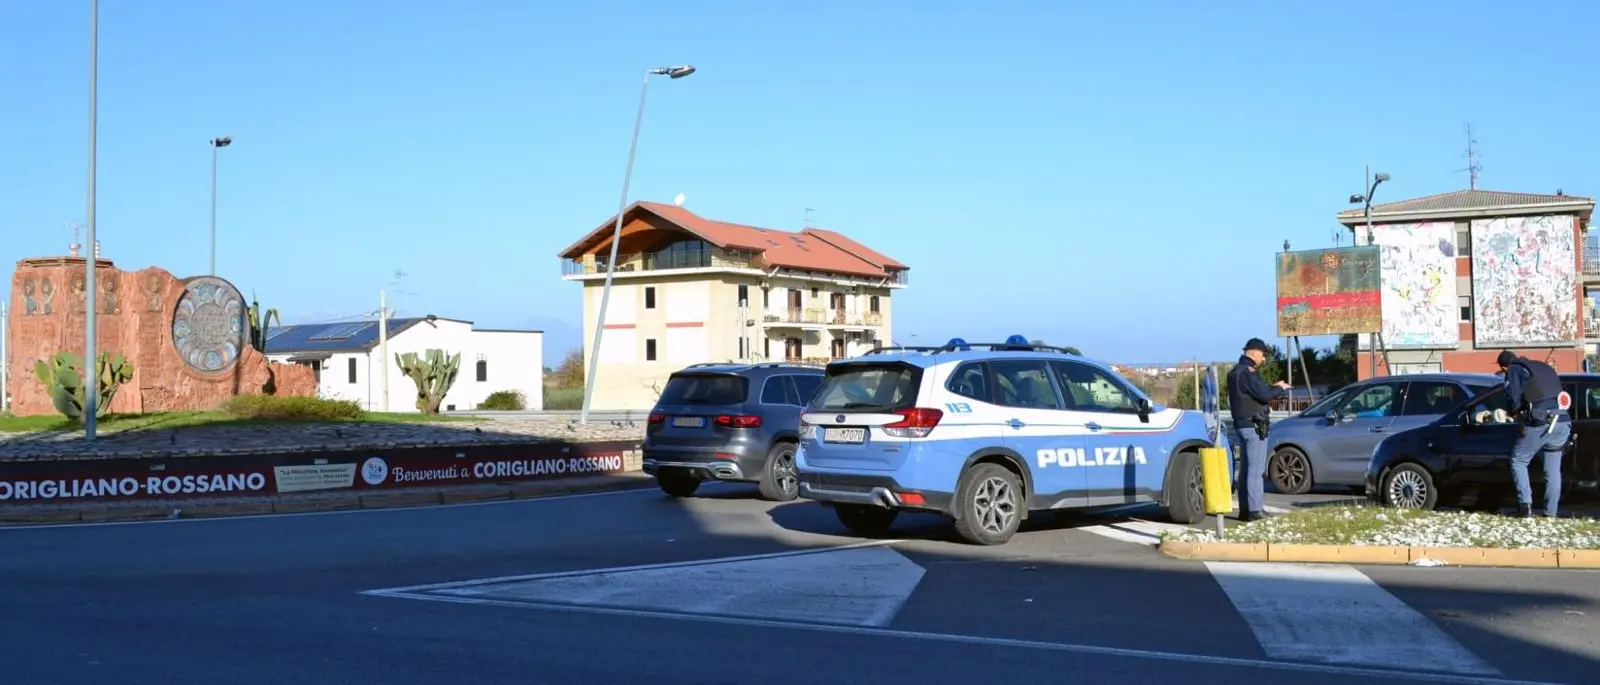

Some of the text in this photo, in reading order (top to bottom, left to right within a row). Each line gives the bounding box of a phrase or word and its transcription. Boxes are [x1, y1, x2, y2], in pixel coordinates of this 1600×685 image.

[945, 402, 973, 413] 113
[1037, 446, 1148, 468] POLIZIA
[392, 464, 459, 482] Benvenuti
[461, 468, 470, 478] a
[474, 456, 621, 478] CORIGLIANO-ROSSANO
